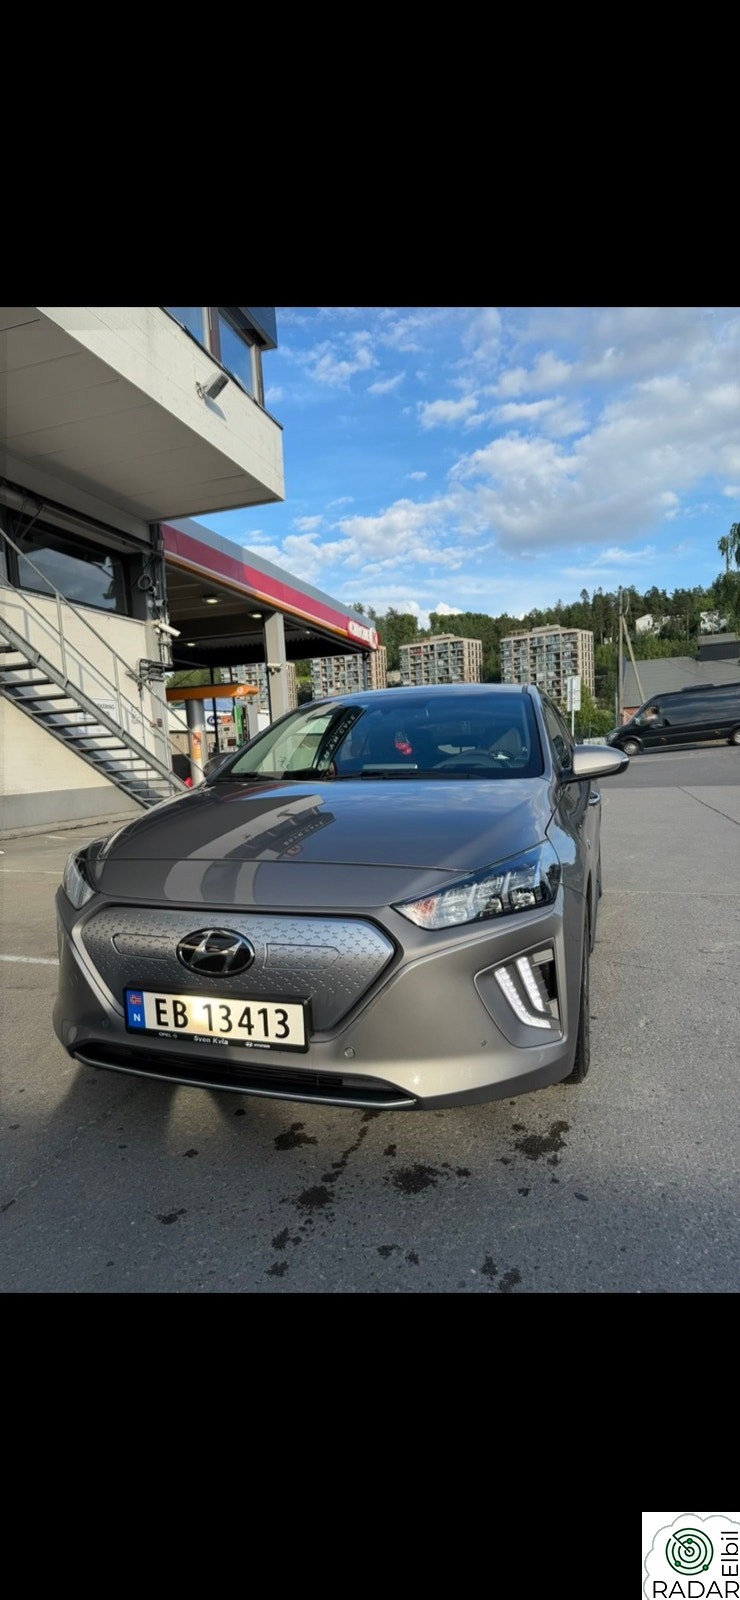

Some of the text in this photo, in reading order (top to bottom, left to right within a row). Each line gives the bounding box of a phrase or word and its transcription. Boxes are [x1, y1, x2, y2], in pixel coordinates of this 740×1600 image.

[133, 1013, 141, 1022] N
[155, 998, 290, 1039] EB 13413
[193, 1035, 211, 1043] Sven
